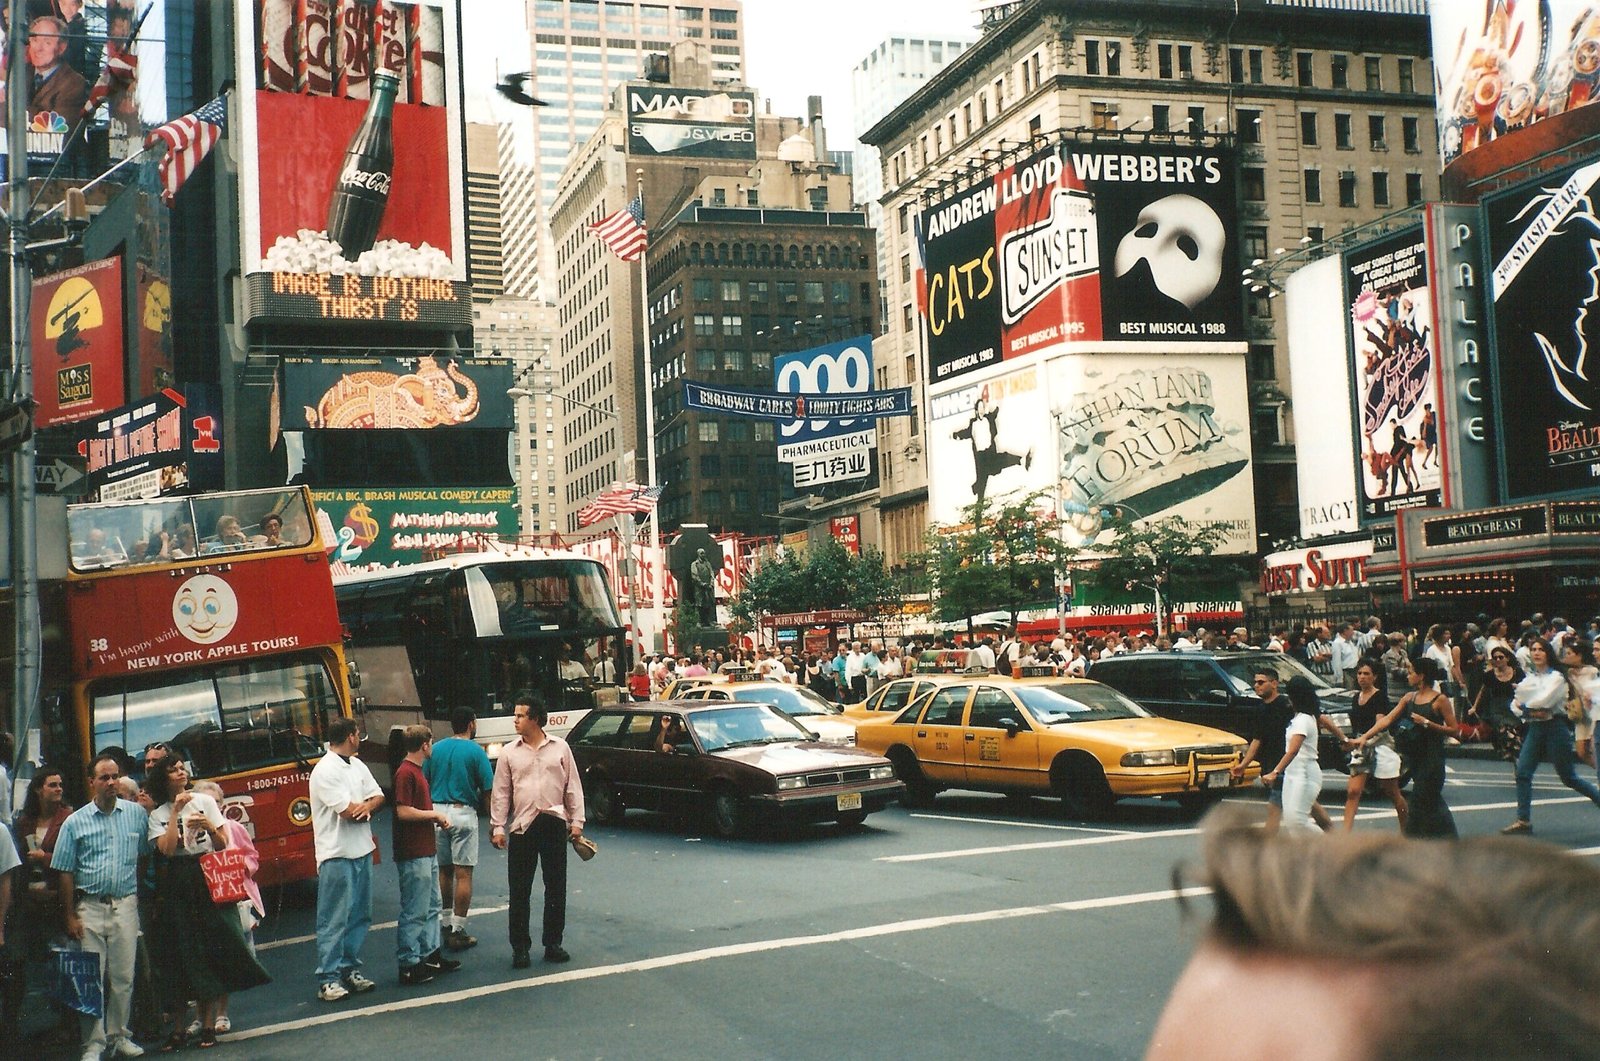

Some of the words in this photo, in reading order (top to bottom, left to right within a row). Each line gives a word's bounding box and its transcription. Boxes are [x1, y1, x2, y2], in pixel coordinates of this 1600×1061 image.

[928, 184, 998, 241] ANDREW
[1003, 155, 1064, 205] LLOYD
[1072, 153, 1221, 184] WEBBER'S
[1018, 227, 1088, 295] SUNSET
[273, 271, 332, 295] IMAGE
[343, 273, 361, 297] IS
[373, 276, 458, 301] NOTHING.
[929, 247, 994, 336] CATS
[318, 297, 388, 319] THIRST
[400, 299, 418, 321] IS
[1011, 337, 1027, 351] BEST
[1028, 325, 1059, 346] MUSICAL
[1120, 322, 1146, 334] BEST
[1149, 322, 1198, 335] MUSICAL
[1200, 323, 1226, 335] 1988
[1454, 223, 1485, 441] PALACE
[60, 382, 90, 400] Saigon
[759, 398, 793, 414] CARES
[842, 398, 873, 414] FIGHTS
[782, 433, 871, 458] PHARMACEUTICAL
[1547, 424, 1600, 453] BEAUT
[1073, 412, 1219, 501] FORUM
[795, 453, 866, 484] 三九药业
[336, 492, 343, 501] A
[365, 491, 395, 501] BRASH
[399, 490, 438, 501] MUSICAL
[440, 490, 478, 500] COMEDY
[834, 516, 855, 527] PEEP
[1447, 522, 1483, 539] BEAUTY
[1489, 518, 1522, 533] BEAST
[1559, 513, 1600, 525] BEAUT
[1089, 604, 1132, 616] sbarro
[1195, 601, 1237, 613] sbarro
[775, 616, 793, 625] DUFFY
[793, 614, 816, 625] SQUARE
[90, 638, 108, 652] 38
[127, 656, 160, 670] NEW
[164, 649, 203, 664] YORK
[207, 643, 248, 658] APPLE
[251, 635, 300, 652] TOURS!
[549, 715, 568, 726] 607
[212, 882, 225, 899] of
